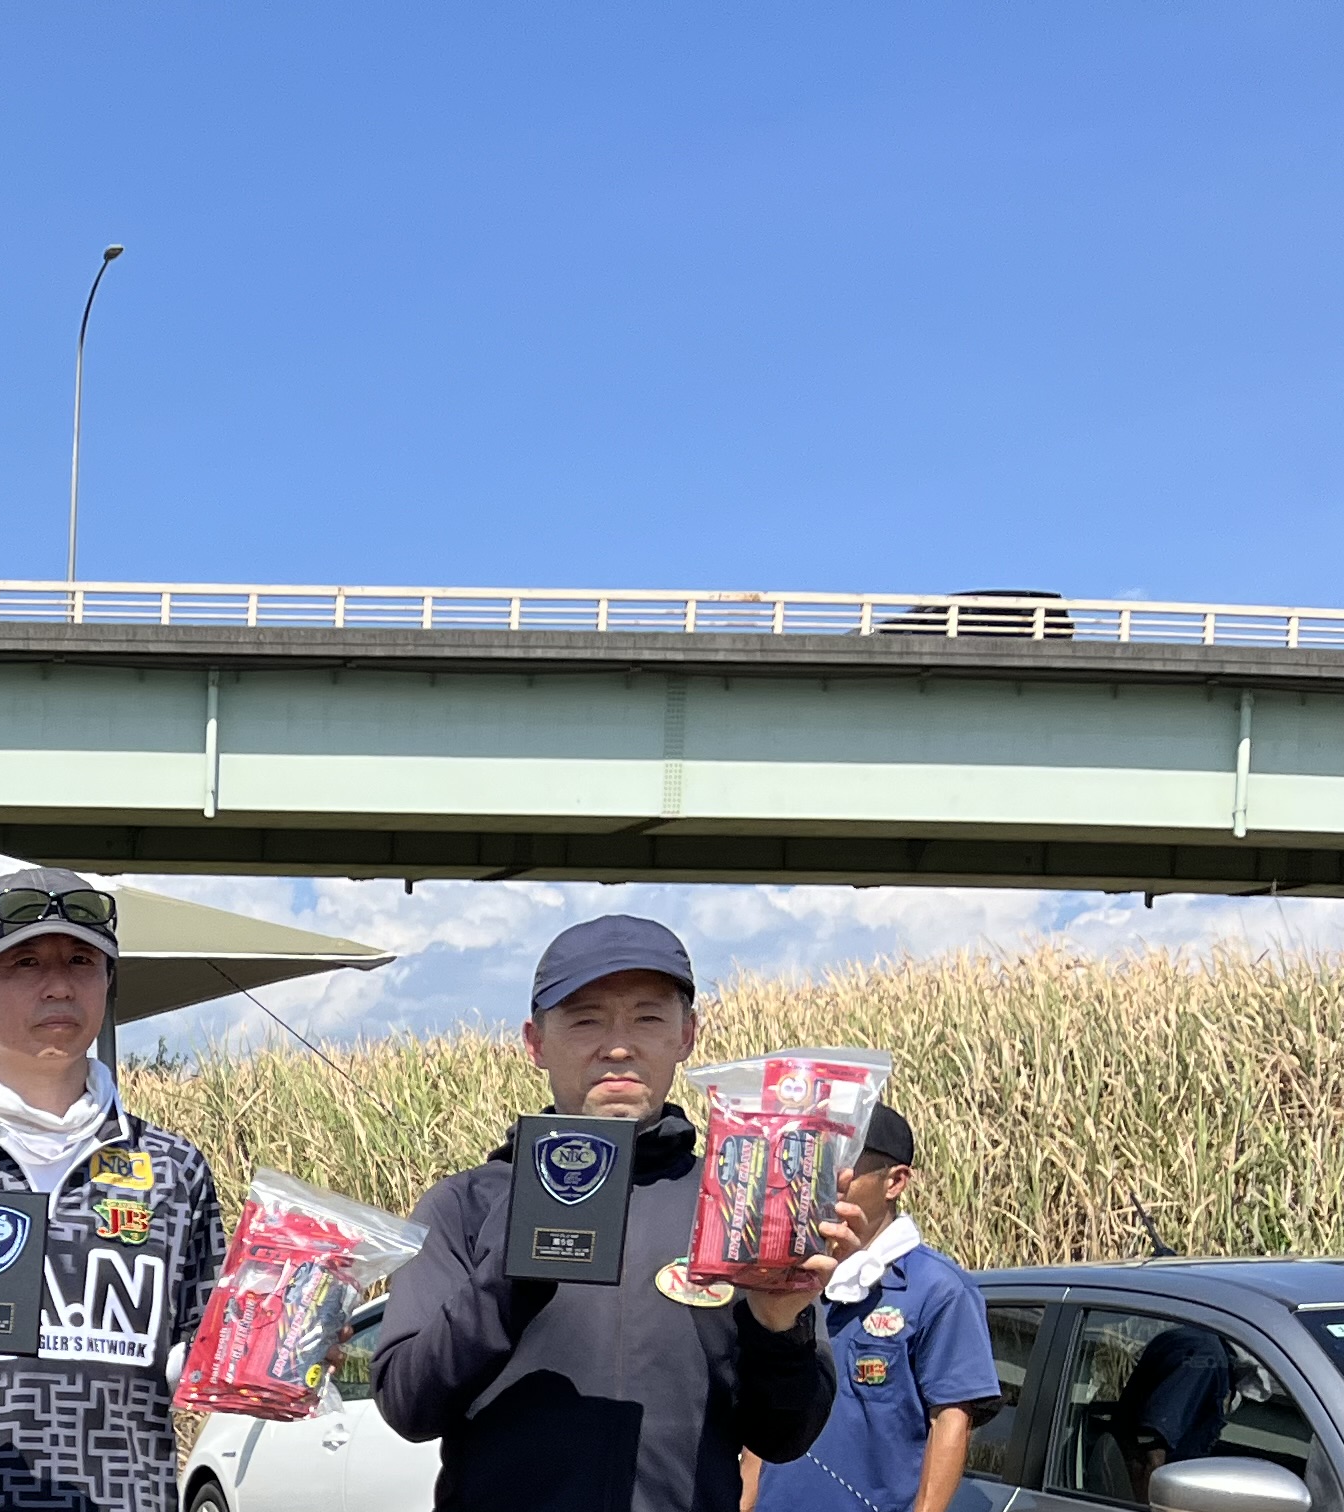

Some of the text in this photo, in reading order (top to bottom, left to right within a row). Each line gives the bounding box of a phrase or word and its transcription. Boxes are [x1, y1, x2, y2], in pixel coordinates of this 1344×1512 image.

[559, 1150, 590, 1164] NBC
[40, 1334, 148, 1358] GLER'S NETWORK
